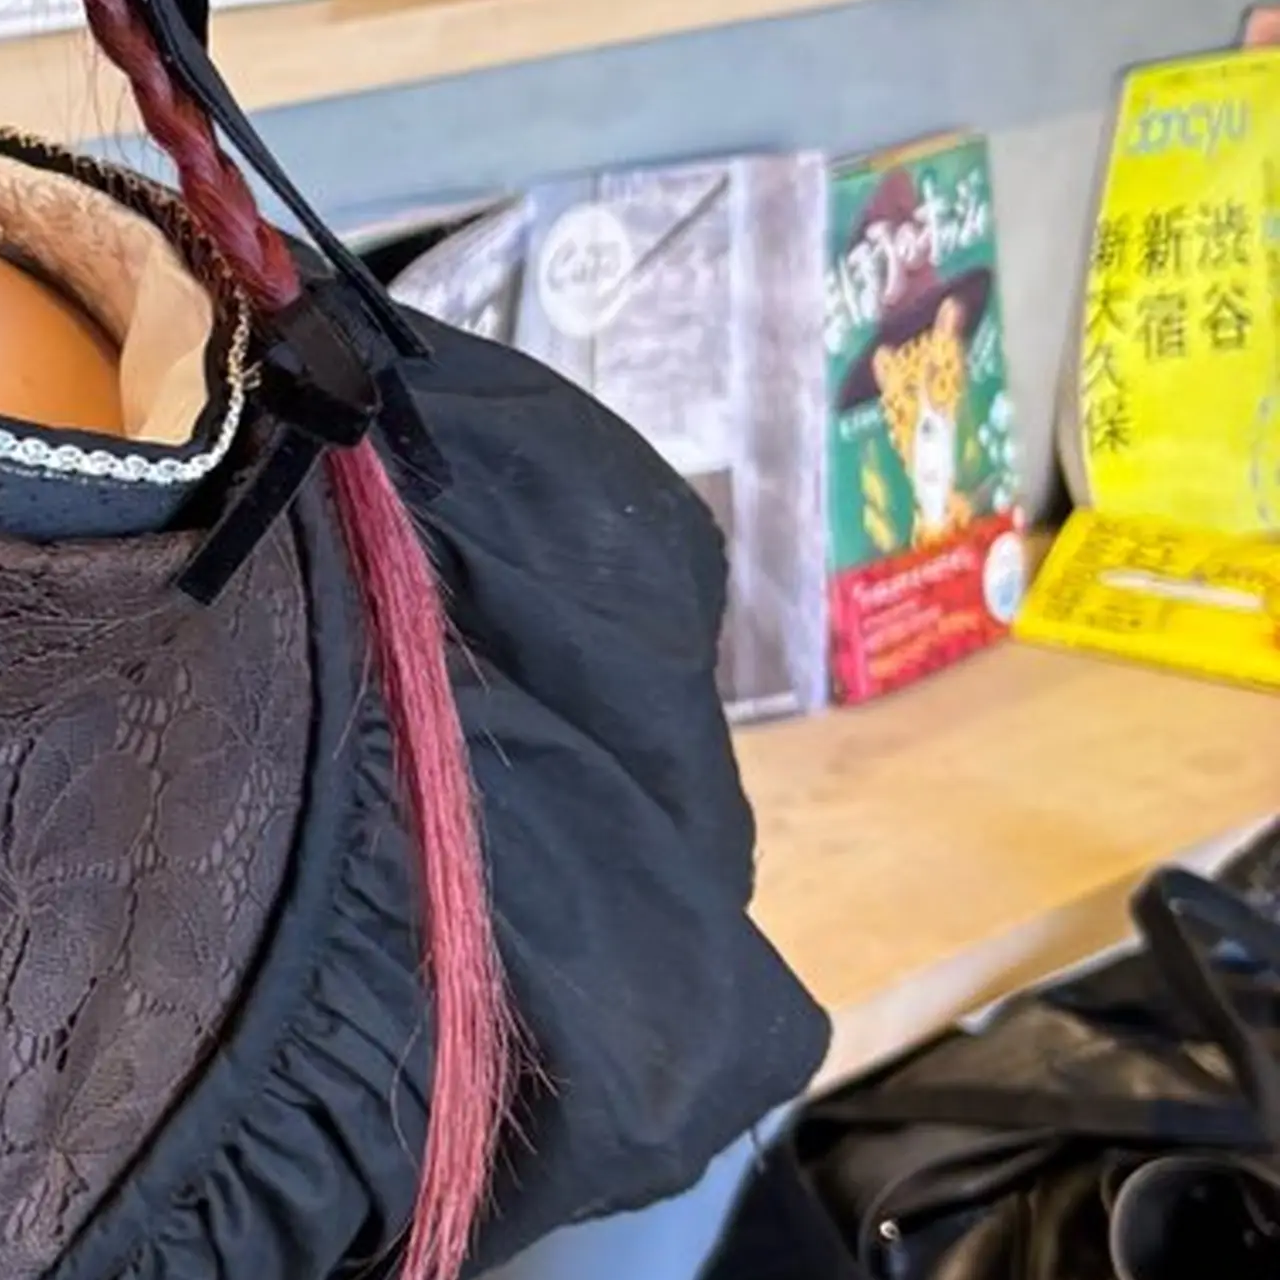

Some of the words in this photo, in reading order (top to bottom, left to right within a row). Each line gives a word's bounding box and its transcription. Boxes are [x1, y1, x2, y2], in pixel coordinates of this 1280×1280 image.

[1084, 217, 1132, 456] 新大久保
[1135, 207, 1188, 362] 新宿
[1196, 198, 1252, 350] 渋谷
